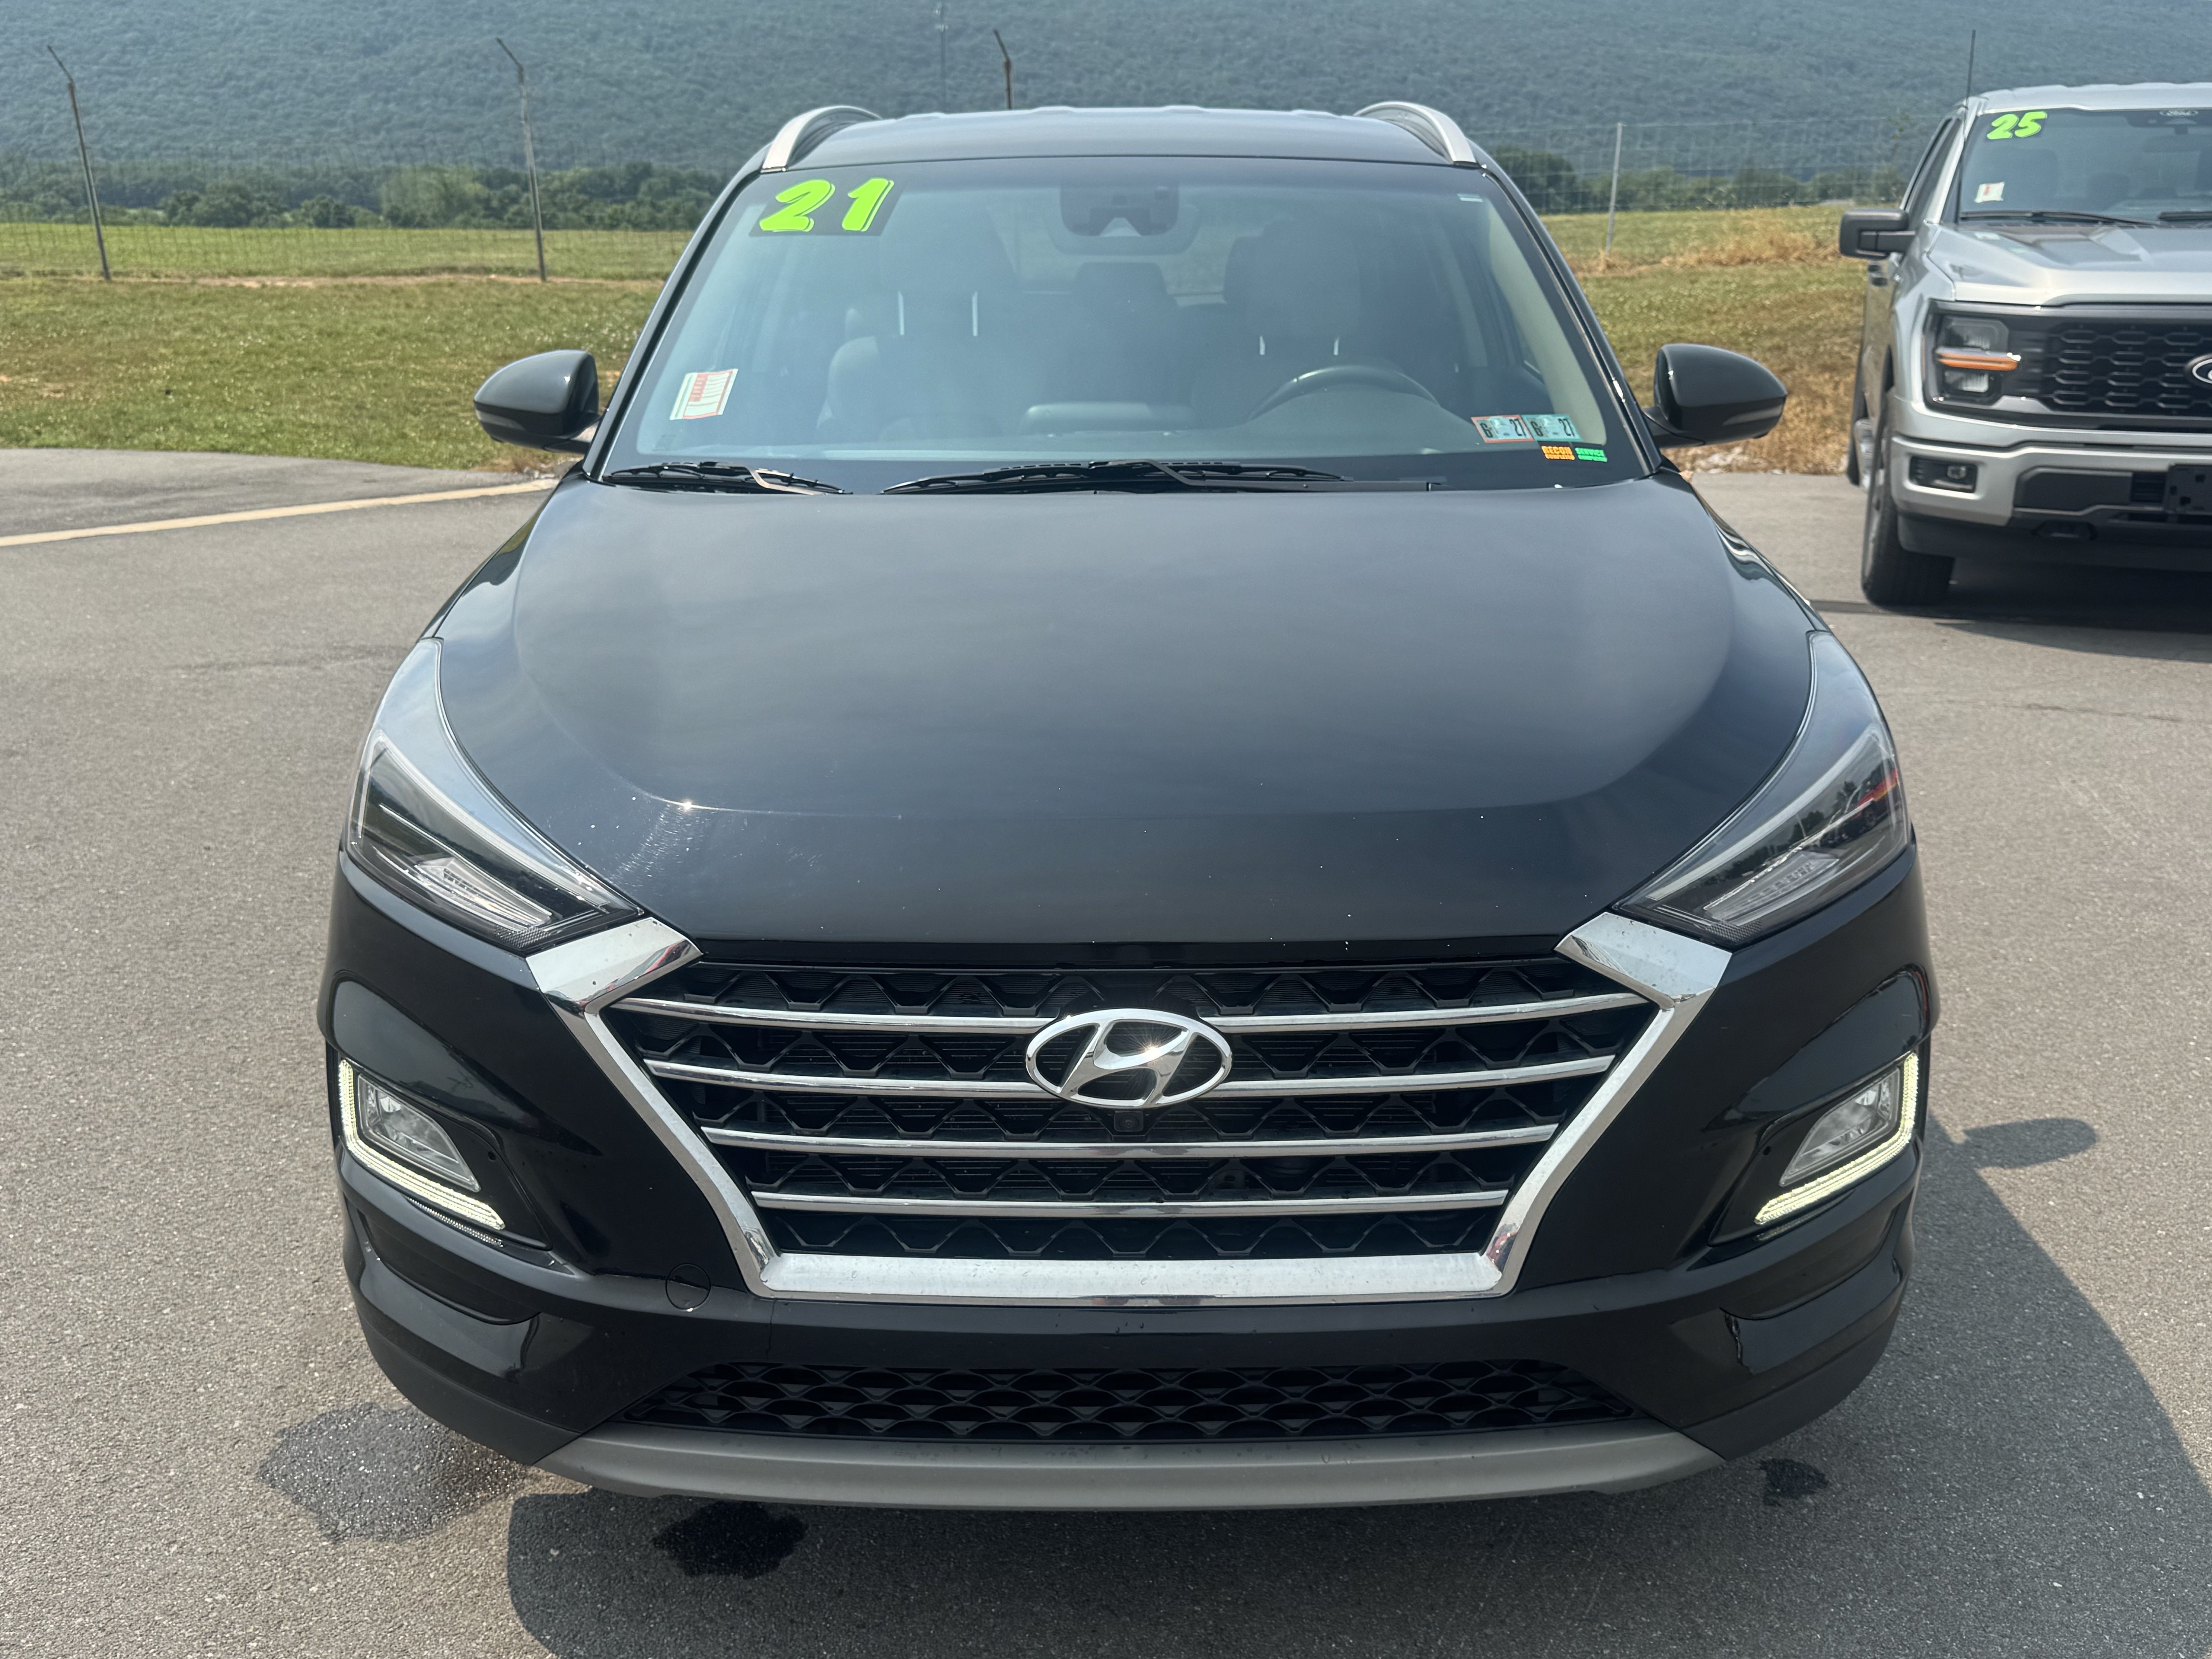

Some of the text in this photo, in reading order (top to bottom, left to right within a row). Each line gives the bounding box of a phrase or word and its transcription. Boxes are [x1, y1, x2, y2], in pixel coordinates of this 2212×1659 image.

[1987, 111, 2047, 140] 25
[759, 178, 894, 232] 21
[1509, 418, 1526, 437] 27
[1558, 418, 1575, 436] 27
[1541, 446, 1573, 455] RECON
